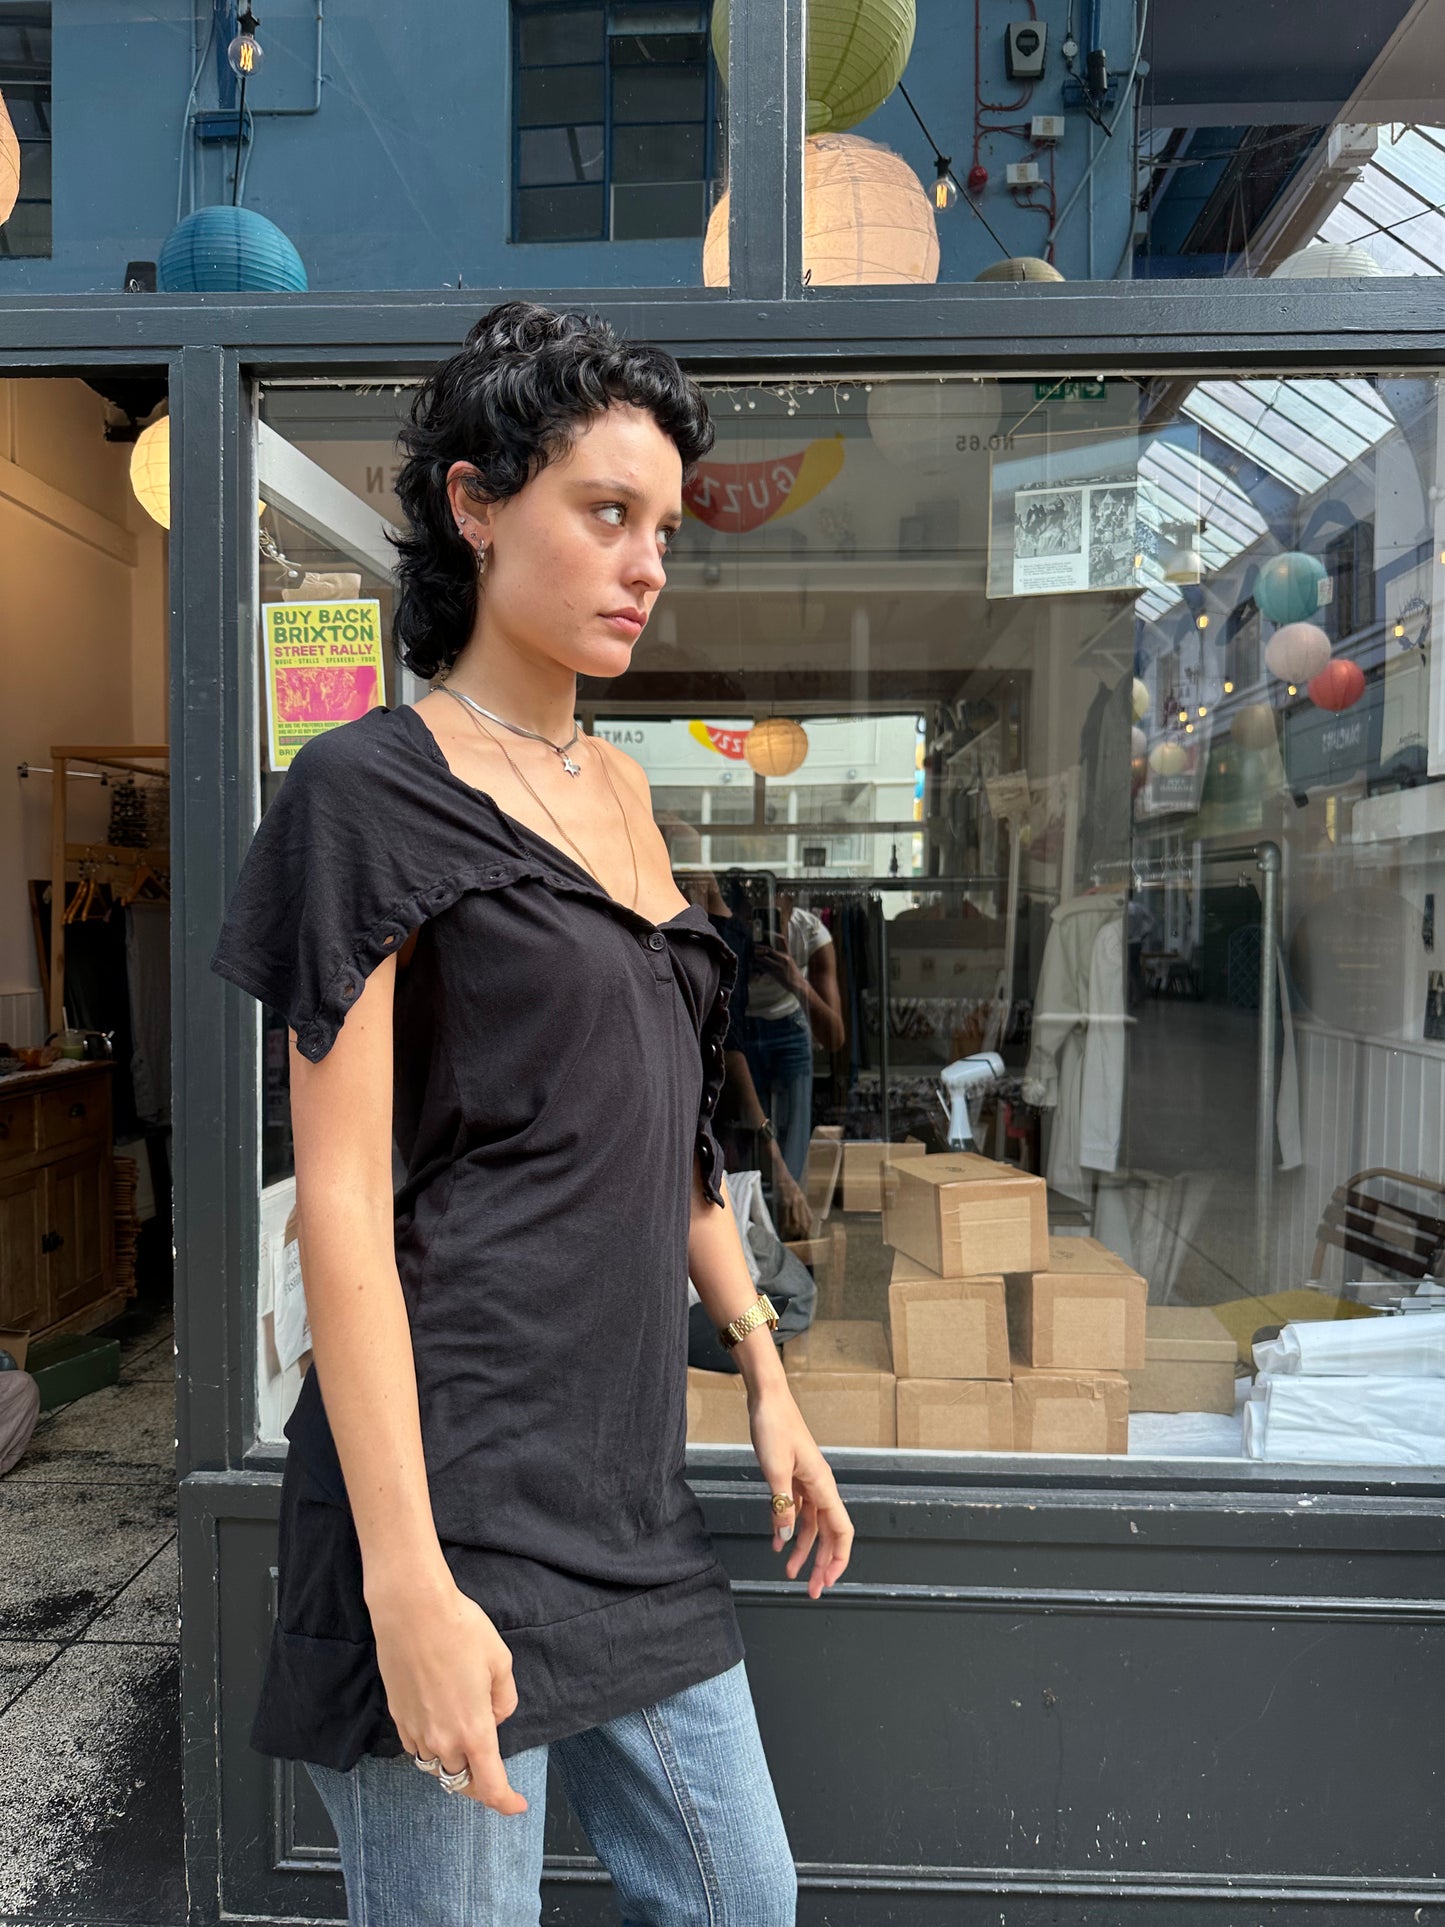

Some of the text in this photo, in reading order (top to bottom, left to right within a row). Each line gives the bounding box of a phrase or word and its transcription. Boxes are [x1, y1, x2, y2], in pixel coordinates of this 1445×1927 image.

[273, 608, 372, 625] BUY BACK
[274, 624, 374, 644] BRIXTON
[274, 644, 373, 657] STREET RALLY
